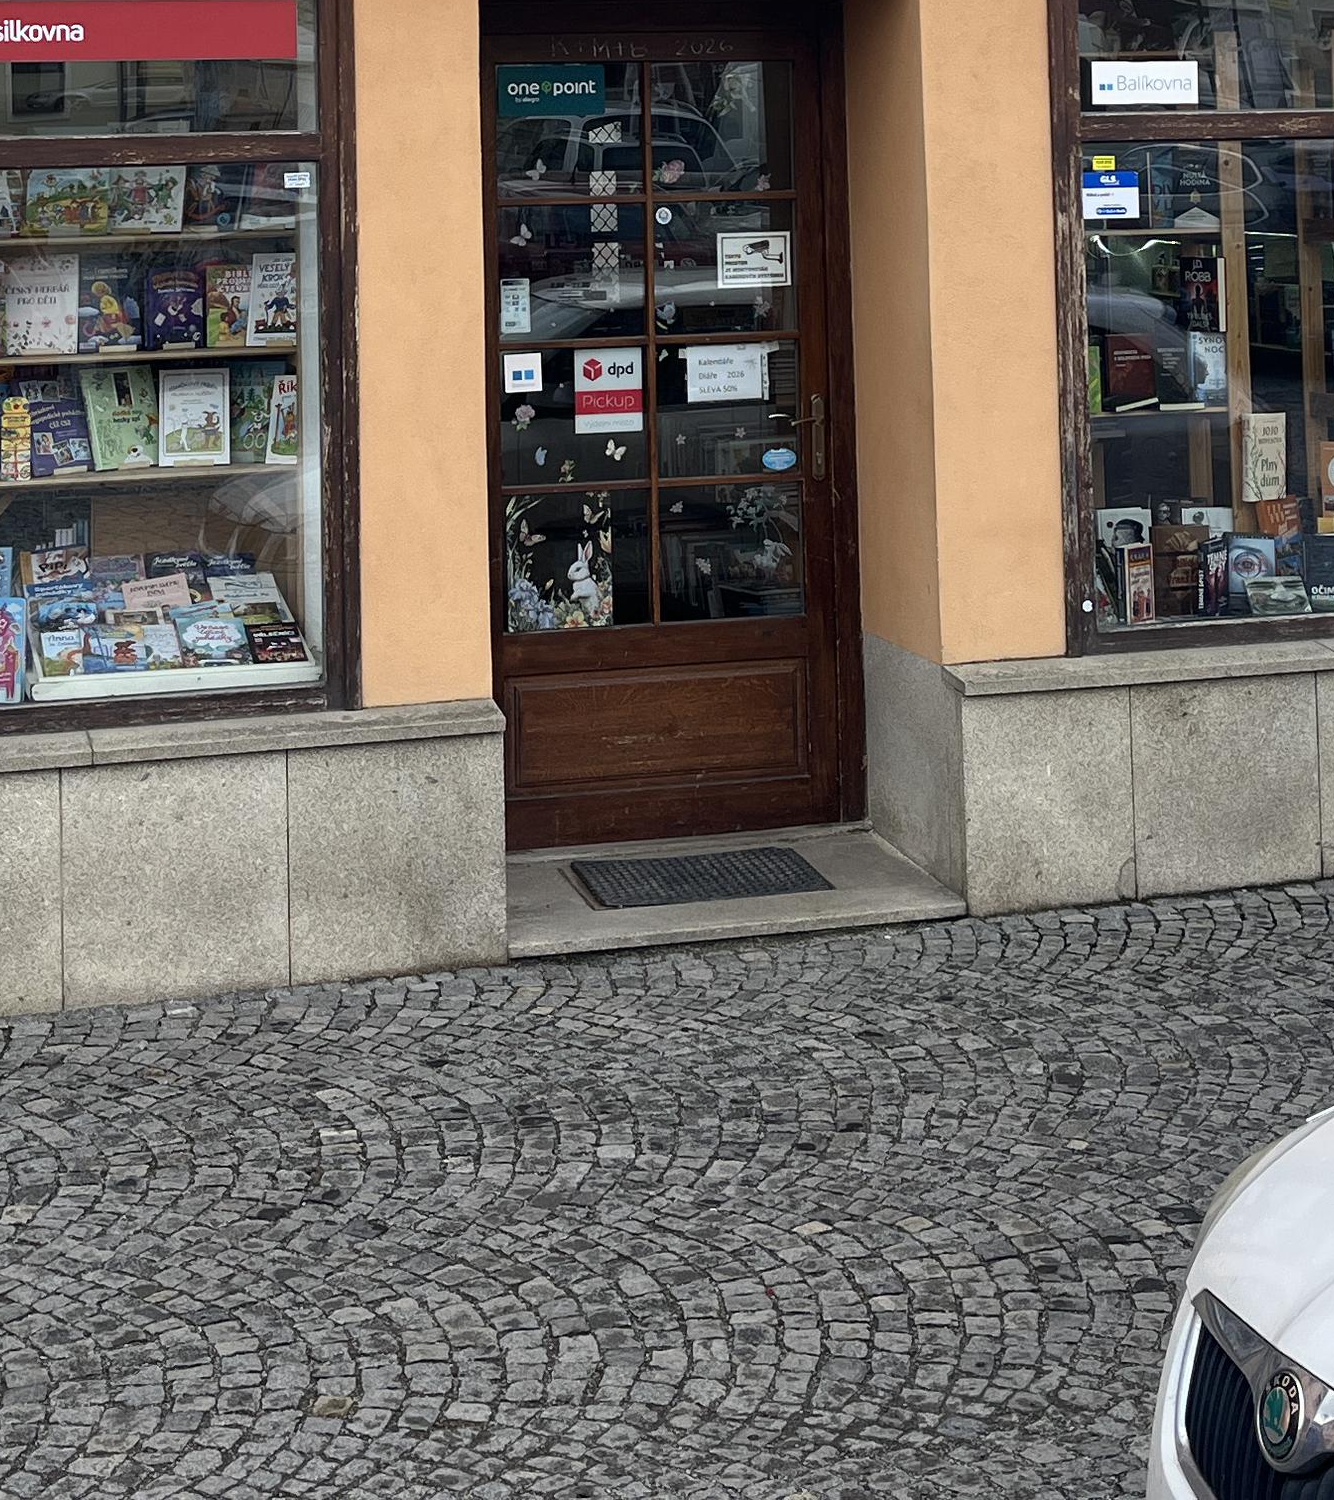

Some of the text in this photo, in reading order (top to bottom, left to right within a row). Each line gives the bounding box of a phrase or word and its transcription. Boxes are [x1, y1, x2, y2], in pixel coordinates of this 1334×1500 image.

[507, 80, 596, 97] one point
[1116, 74, 1192, 92] Balíkovna
[1185, 271, 1212, 282] ROBB
[17, 297, 35, 306] PRO
[1198, 336, 1226, 345] SYNO
[607, 361, 634, 378] dpd
[727, 370, 745, 379] 2026
[582, 393, 635, 409] Pickup
[1262, 426, 1279, 436] JOJO
